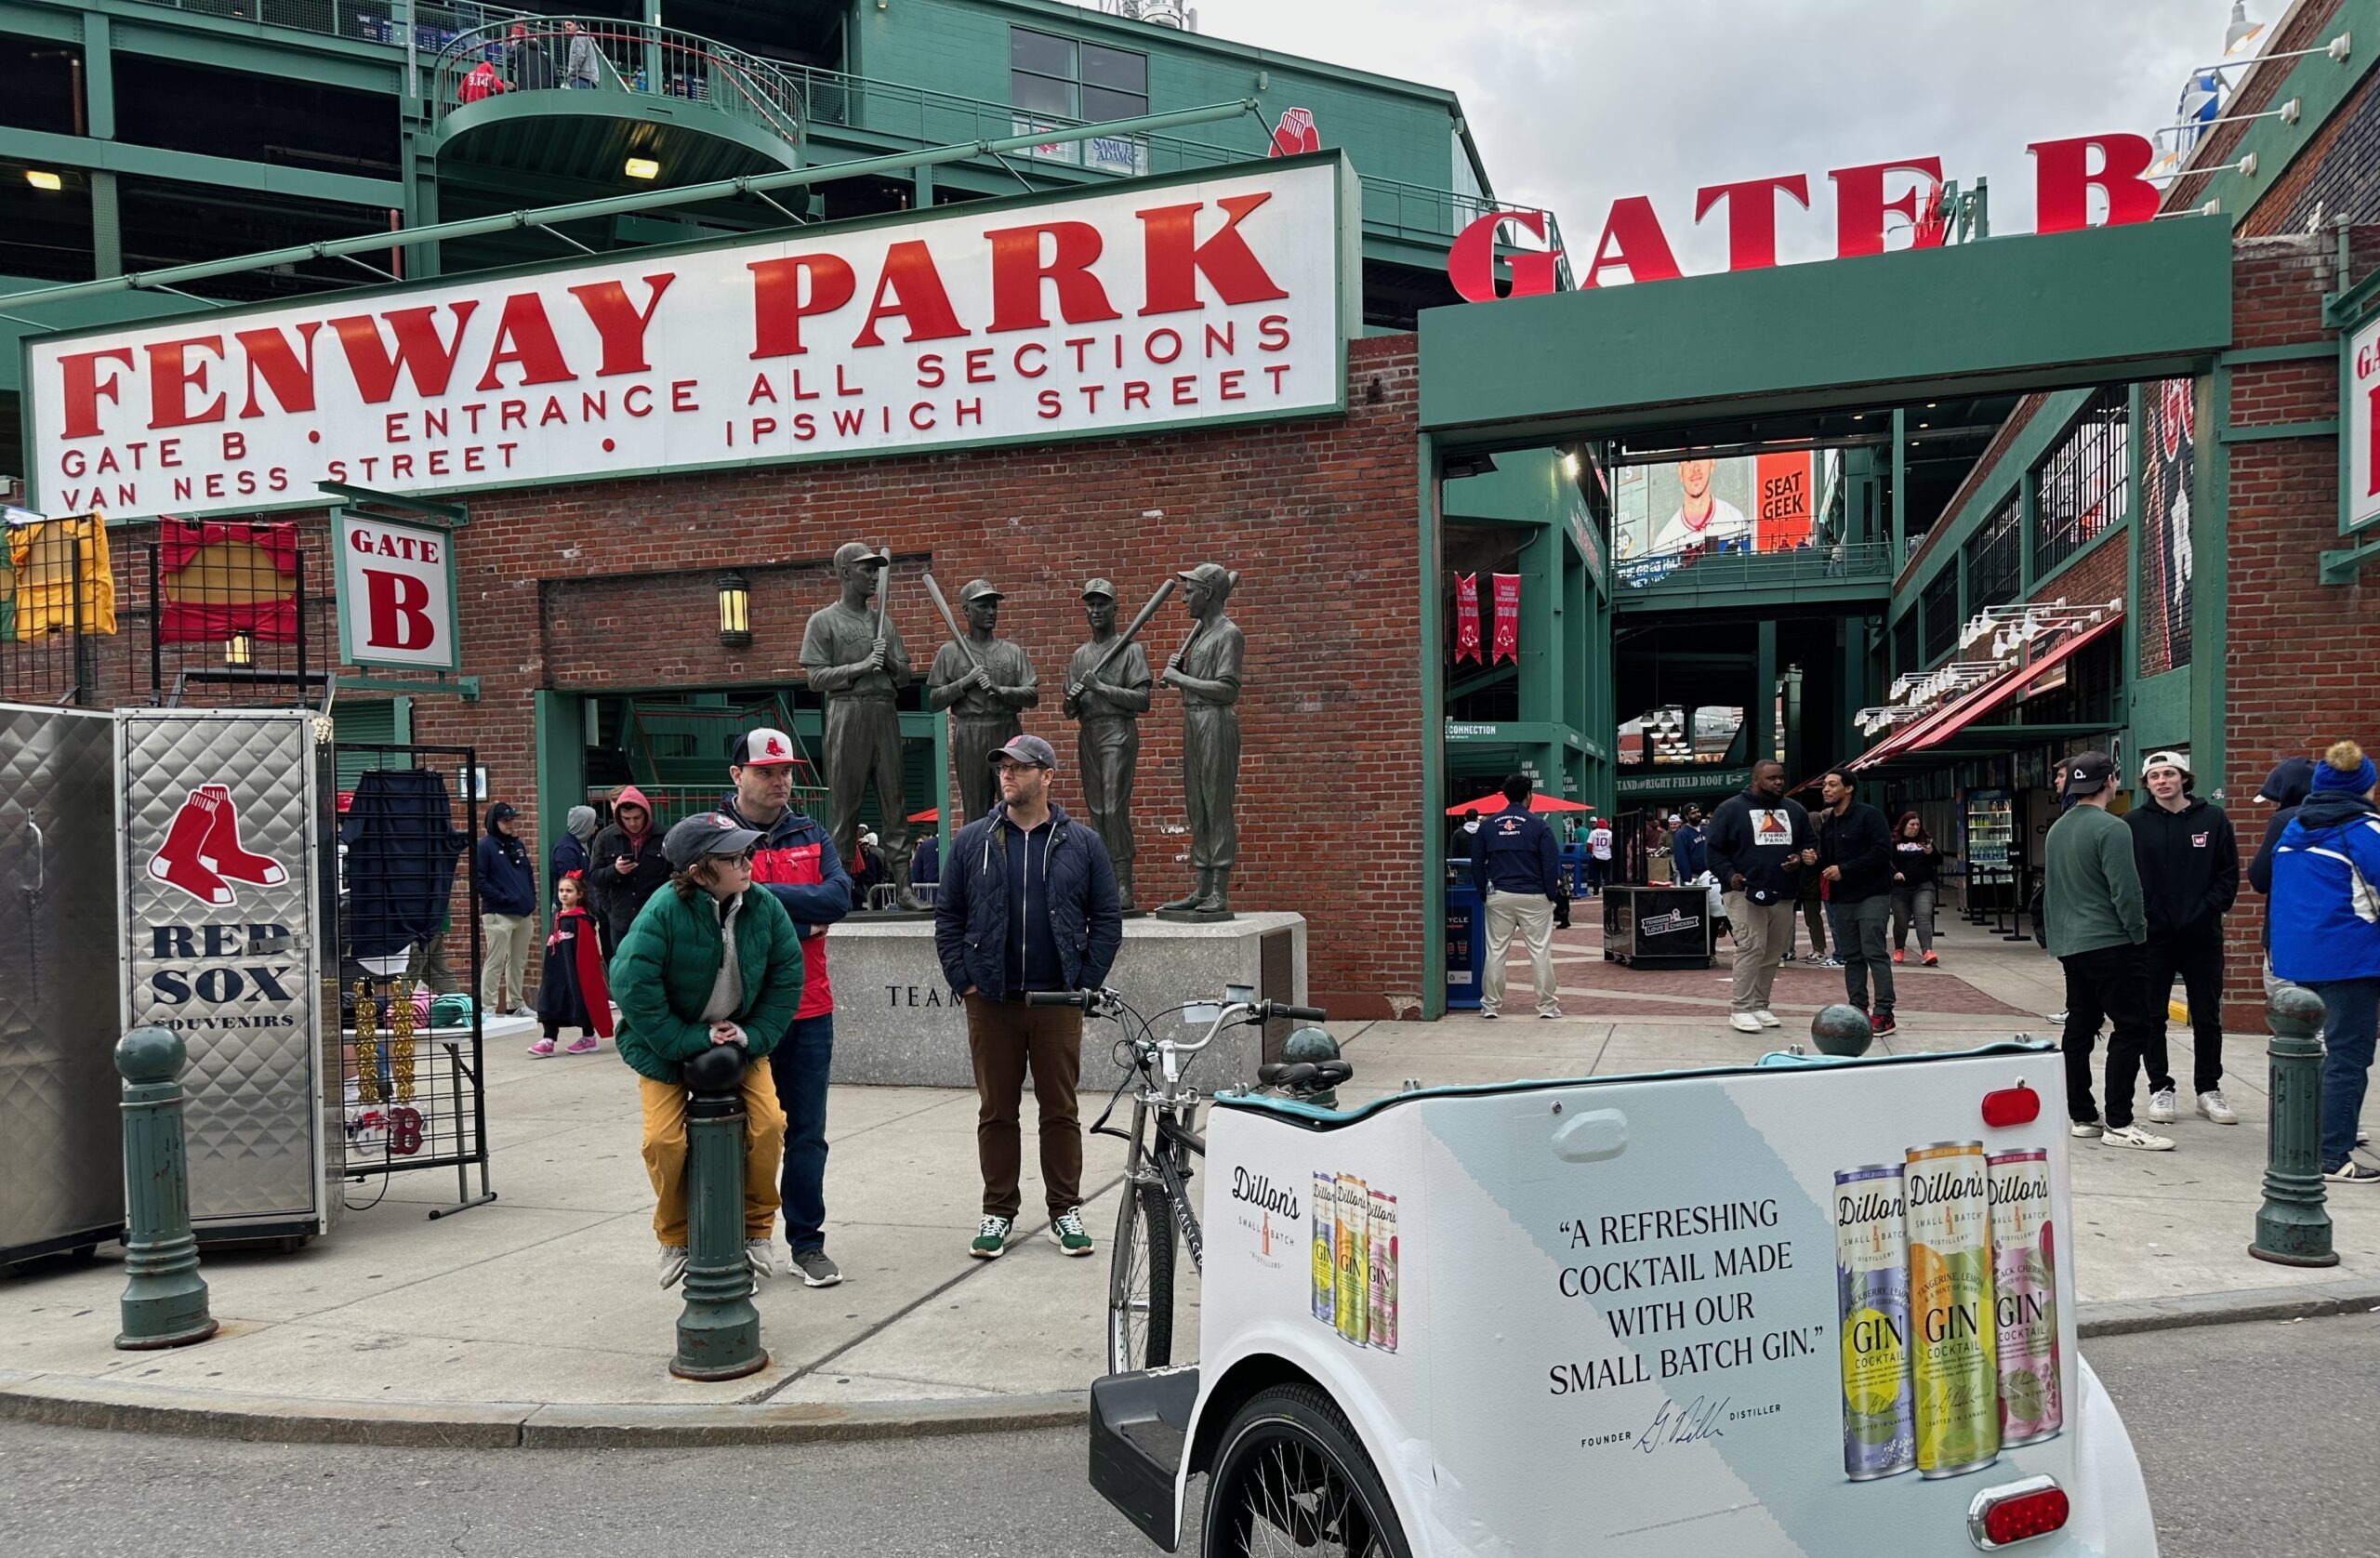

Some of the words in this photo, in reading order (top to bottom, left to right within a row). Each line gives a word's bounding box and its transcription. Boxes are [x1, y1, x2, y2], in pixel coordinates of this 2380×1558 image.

[1093, 138, 1132, 154] SAMUE
[1447, 155, 1945, 304] GATE
[2026, 133, 2161, 235] B
[58, 272, 676, 440] FENWAY
[746, 192, 1289, 360] PARK
[61, 438, 182, 479] GATE
[223, 432, 246, 461] B
[386, 379, 699, 443] ENTRANCE
[747, 363, 864, 405] ALL
[918, 314, 1290, 388] SECTIONS
[61, 483, 136, 511] VAN
[175, 467, 288, 501] NESS
[328, 442, 518, 485] STREET
[727, 397, 982, 446] IPSWICH
[1038, 364, 1290, 419] STREET
[1765, 470, 1803, 500] SEAT
[1763, 493, 1805, 521] GEEK
[350, 529, 440, 564] GATE
[362, 569, 435, 651] B
[1448, 725, 1496, 734] CONNECTION
[1646, 778, 1672, 789] RIGHT
[1673, 776, 1699, 788] FIELD
[1699, 775, 1724, 786] ROOF
[1595, 838, 1608, 847] 10
[150, 923, 292, 958] RED
[152, 966, 294, 1005] SOX
[1232, 1165, 1301, 1220] Dillon's
[1314, 1183, 1336, 1204] Dillon
[1910, 1170, 1984, 1208] Dillon's
[1988, 1175, 2048, 1207] Dillon's
[1173, 1197, 1196, 1240] MAIN
[1559, 1219, 1592, 1249] “A
[1600, 1198, 1778, 1246] REFRESHING
[1839, 1191, 1907, 1227] Dillon'
[1915, 1217, 1943, 1228] SMALL
[1954, 1211, 1982, 1222] BATCH
[1992, 1215, 2012, 1225] MALL
[2022, 1211, 2047, 1221] BATCH
[1238, 1216, 1261, 1233] SMALL
[1270, 1229, 1294, 1247] BATCH
[1844, 1235, 1871, 1247] SMALL
[1930, 1235, 1969, 1246] DISTILLERS
[1316, 1244, 1334, 1265] GIN
[1341, 1254, 1362, 1278] GIN
[1559, 1252, 1705, 1298] COCKTAIL
[1714, 1241, 1793, 1278] MADE
[1368, 1265, 1390, 1288] GIN
[1606, 1301, 1686, 1339] WITH
[1695, 1291, 1755, 1327] OUR
[1925, 1301, 1977, 1343] GIN
[1997, 1291, 2043, 1327] GIN
[1853, 1314, 1903, 1353] GIN
[1998, 1326, 2045, 1342] COCKTAIL
[1549, 1353, 1651, 1395] SMALL
[1660, 1337, 1753, 1379] BATCH
[1762, 1326, 1824, 1361] GIN.”
[1855, 1351, 1906, 1369] COCKTAIL
[1927, 1340, 1980, 1360] COCKTAIL
[1729, 1404, 1781, 1421] DISTILLER
[1581, 1432, 1632, 1447] FOUNDER
